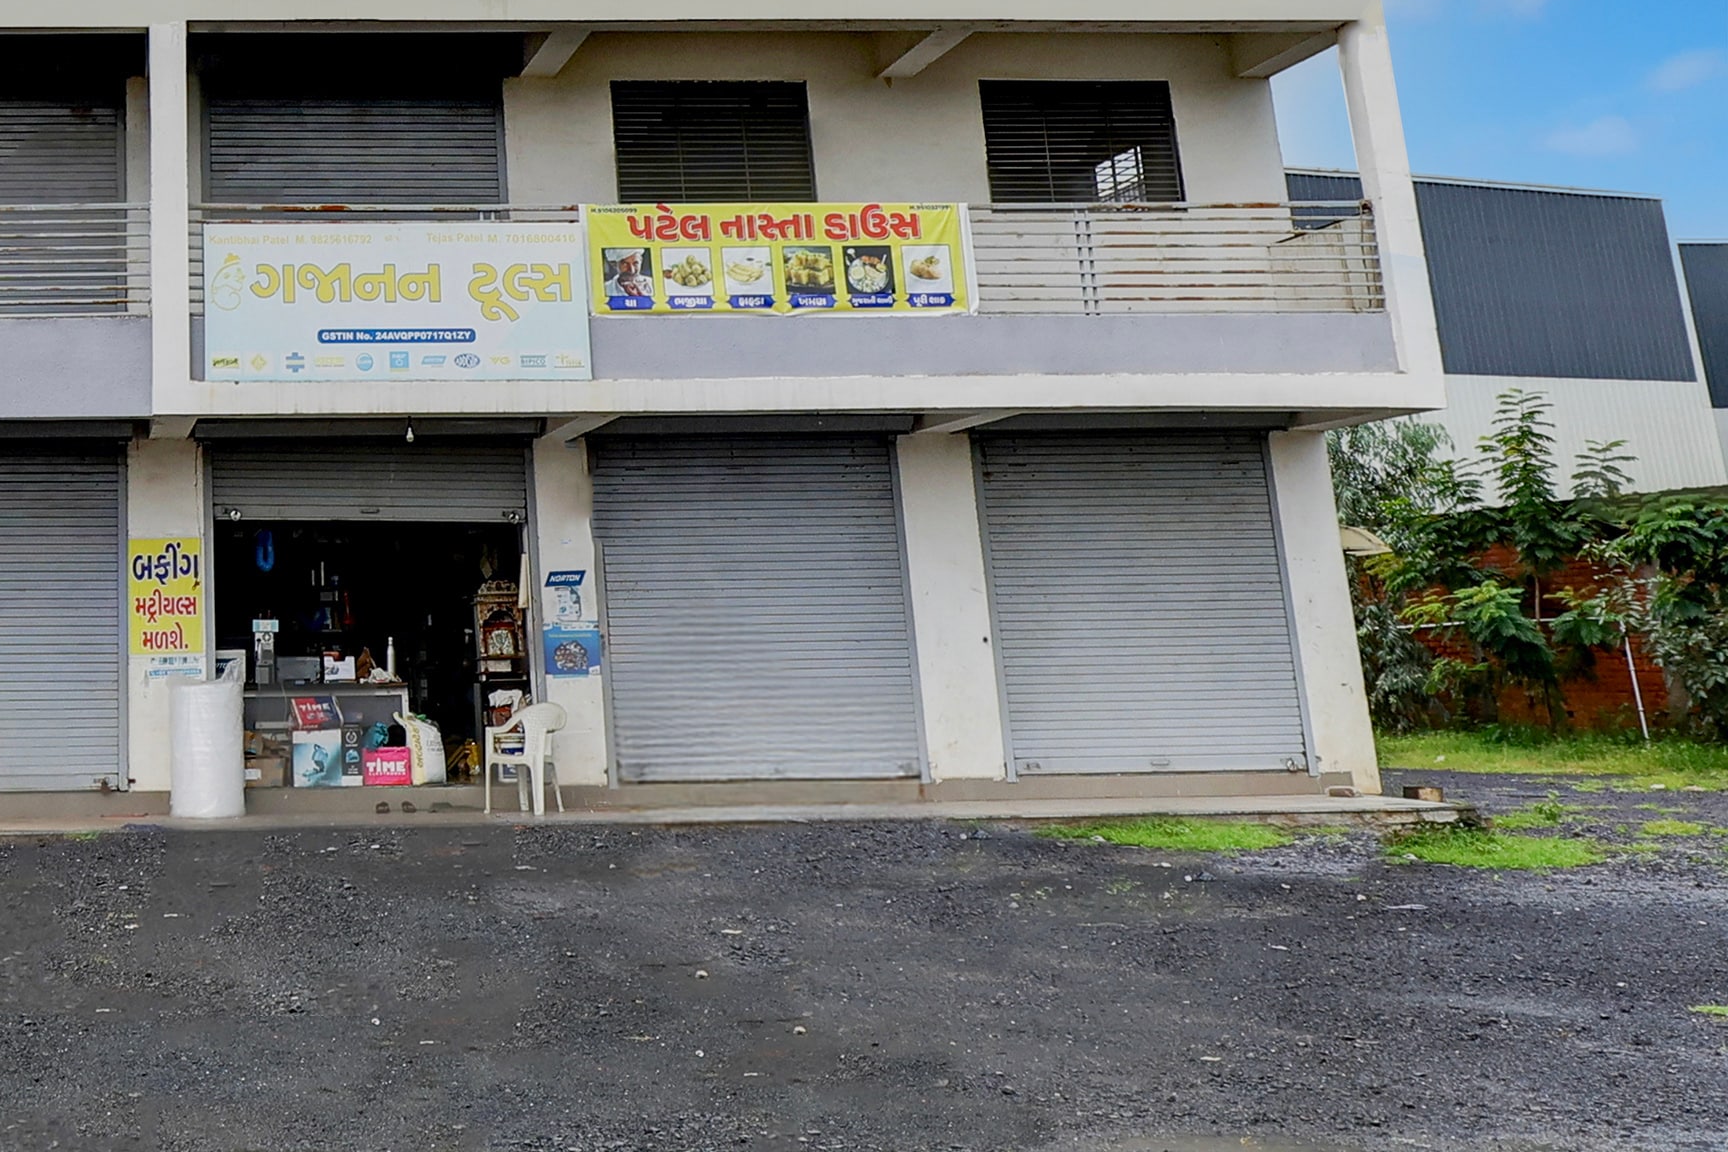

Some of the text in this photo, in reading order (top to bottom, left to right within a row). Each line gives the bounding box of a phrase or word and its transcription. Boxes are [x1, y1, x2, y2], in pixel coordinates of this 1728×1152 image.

[627, 201, 921, 240] પટેલ નાસ્તા હાઉસ
[209, 233, 259, 244] Kantibhai
[263, 233, 289, 244] Patel
[426, 232, 453, 244] Tejas
[456, 233, 483, 243] Patel
[249, 262, 573, 323] ગજાનન ટૂલ્સ
[322, 331, 353, 340] GSTIN
[356, 332, 373, 340] No.
[549, 574, 581, 583] NORTON
[366, 757, 406, 772] TIME
